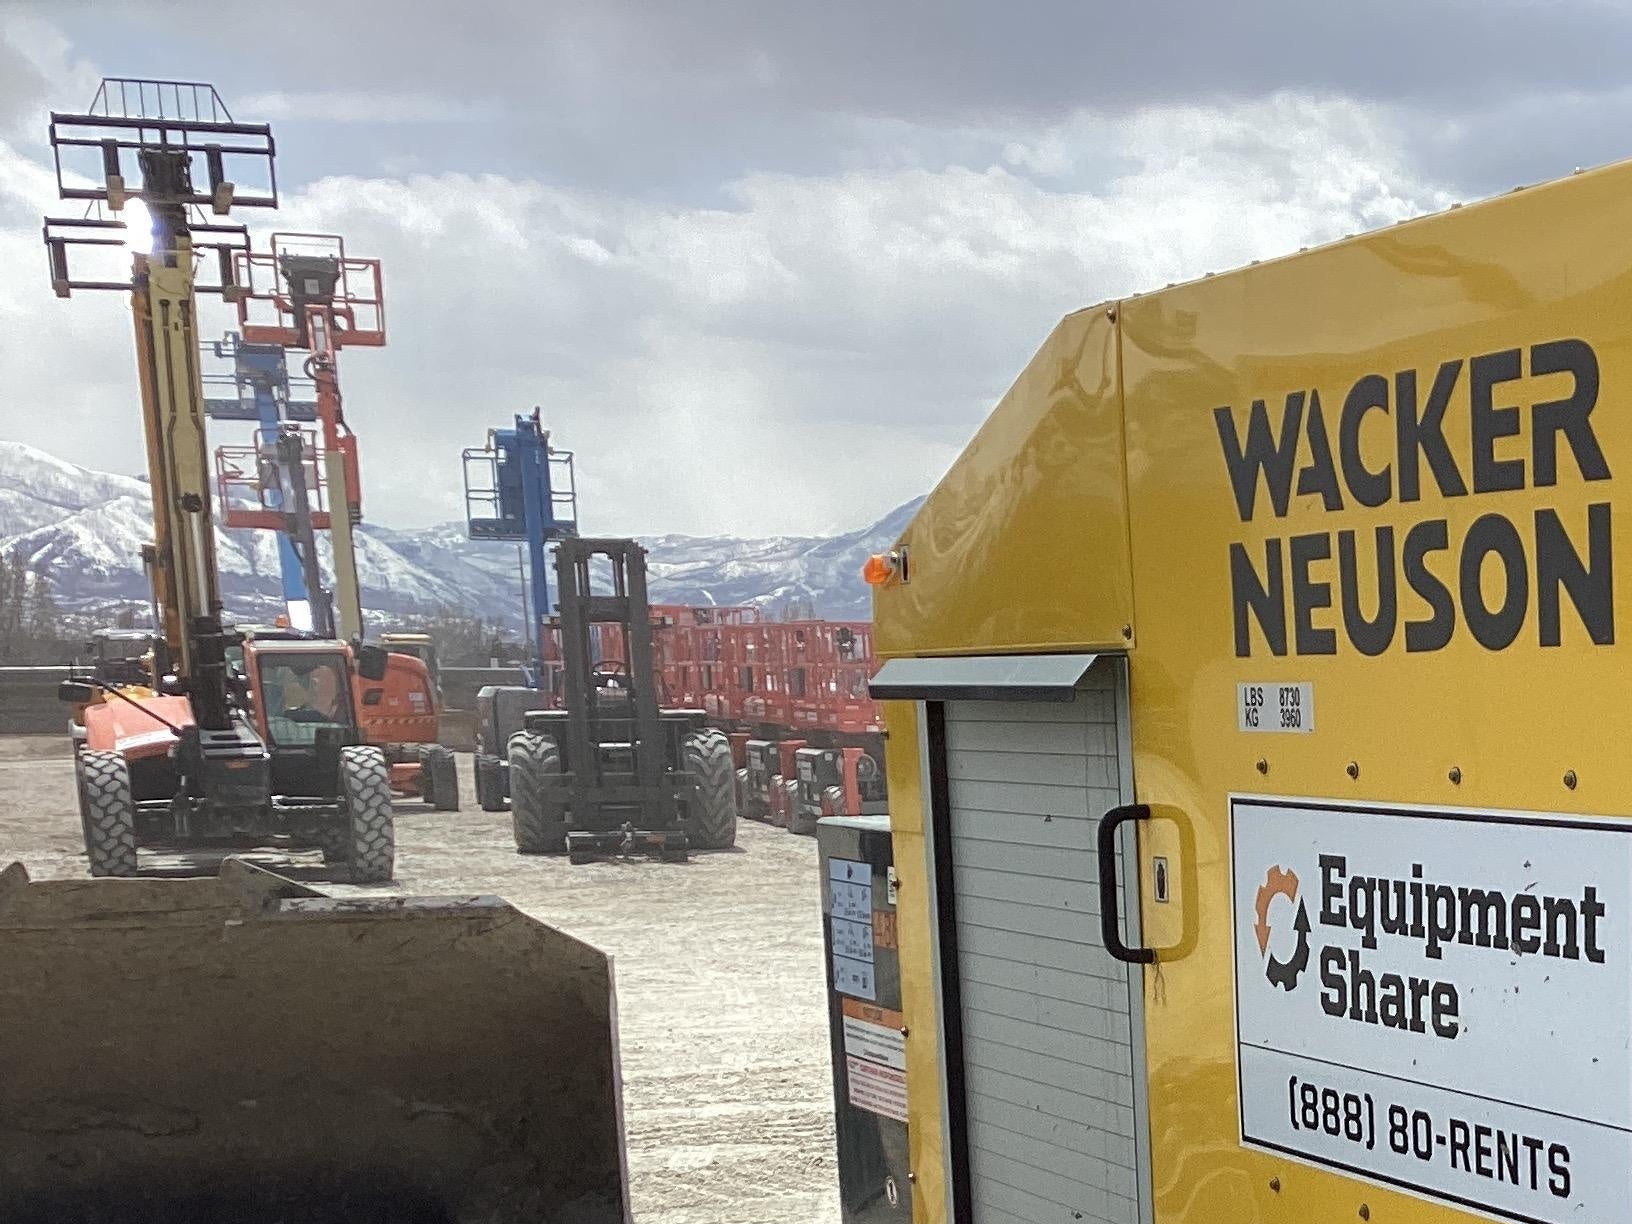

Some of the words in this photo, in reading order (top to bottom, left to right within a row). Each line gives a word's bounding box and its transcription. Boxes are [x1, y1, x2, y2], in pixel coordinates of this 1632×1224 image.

[1213, 338, 1612, 521] WACKER
[1230, 502, 1615, 656] NEUSON
[1244, 687, 1263, 706] LBS
[1279, 687, 1300, 706] 8730
[1245, 708, 1259, 727] KG
[1280, 708, 1301, 727] 3960
[1318, 854, 1605, 963] Equipment
[1319, 946, 1460, 1039] Share
[1288, 1075, 1375, 1149] (888)
[1388, 1104, 1571, 1198] 80-RENTS
